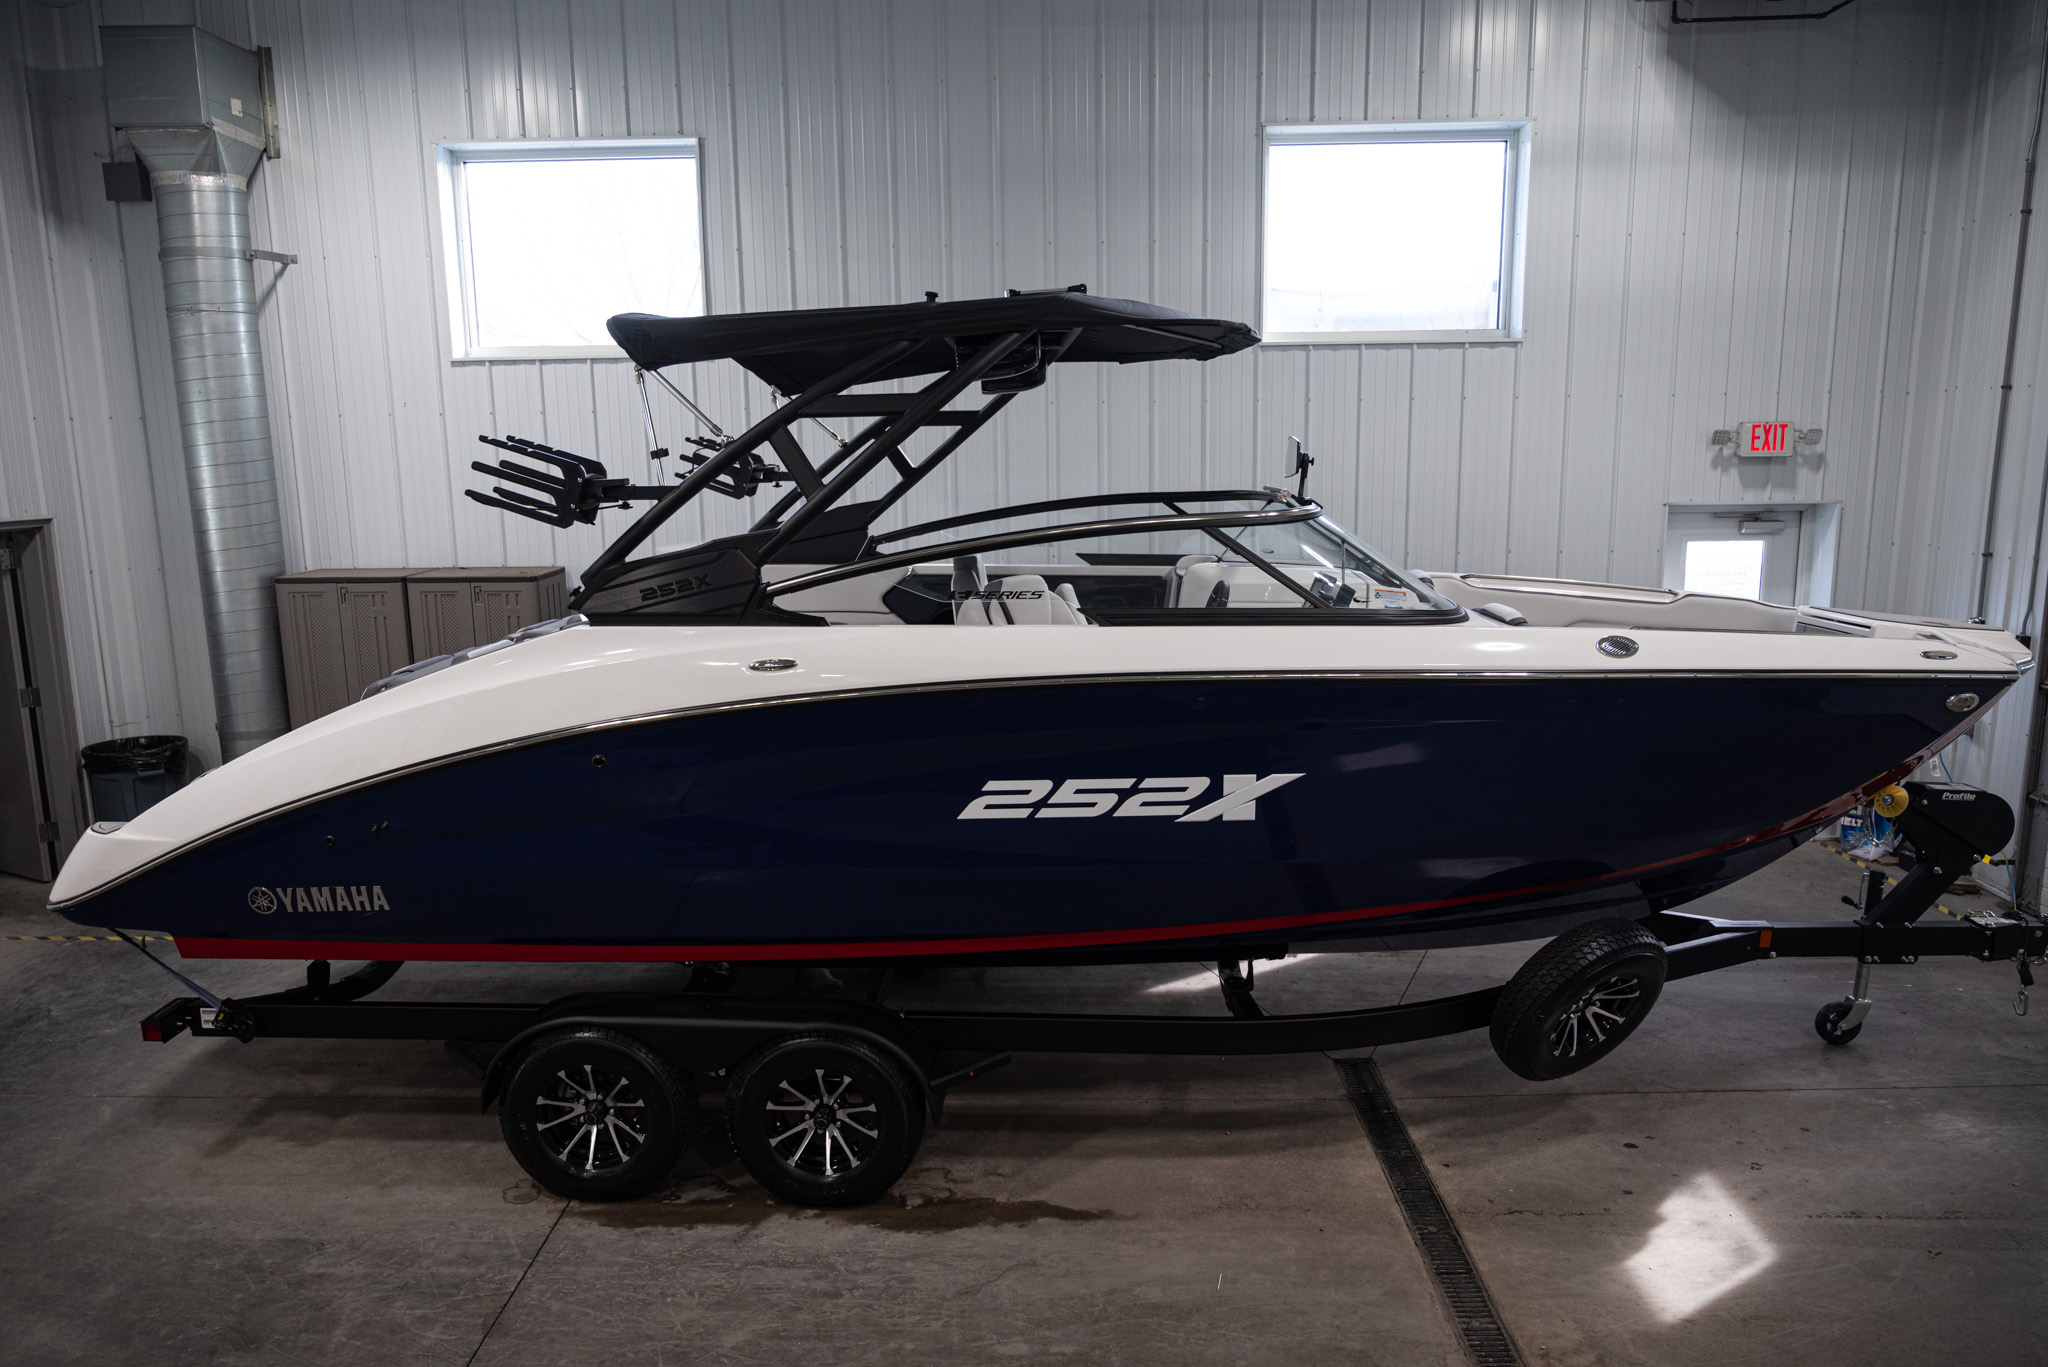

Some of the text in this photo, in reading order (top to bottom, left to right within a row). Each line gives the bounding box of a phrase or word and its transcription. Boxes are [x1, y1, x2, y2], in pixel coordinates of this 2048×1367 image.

[1751, 424, 1788, 451] EXIT
[640, 573, 711, 602] 252X
[972, 590, 1045, 600] SERIES
[957, 773, 1306, 822] 252X
[1941, 792, 1976, 801] Profile
[275, 885, 391, 912] YAMAHA
